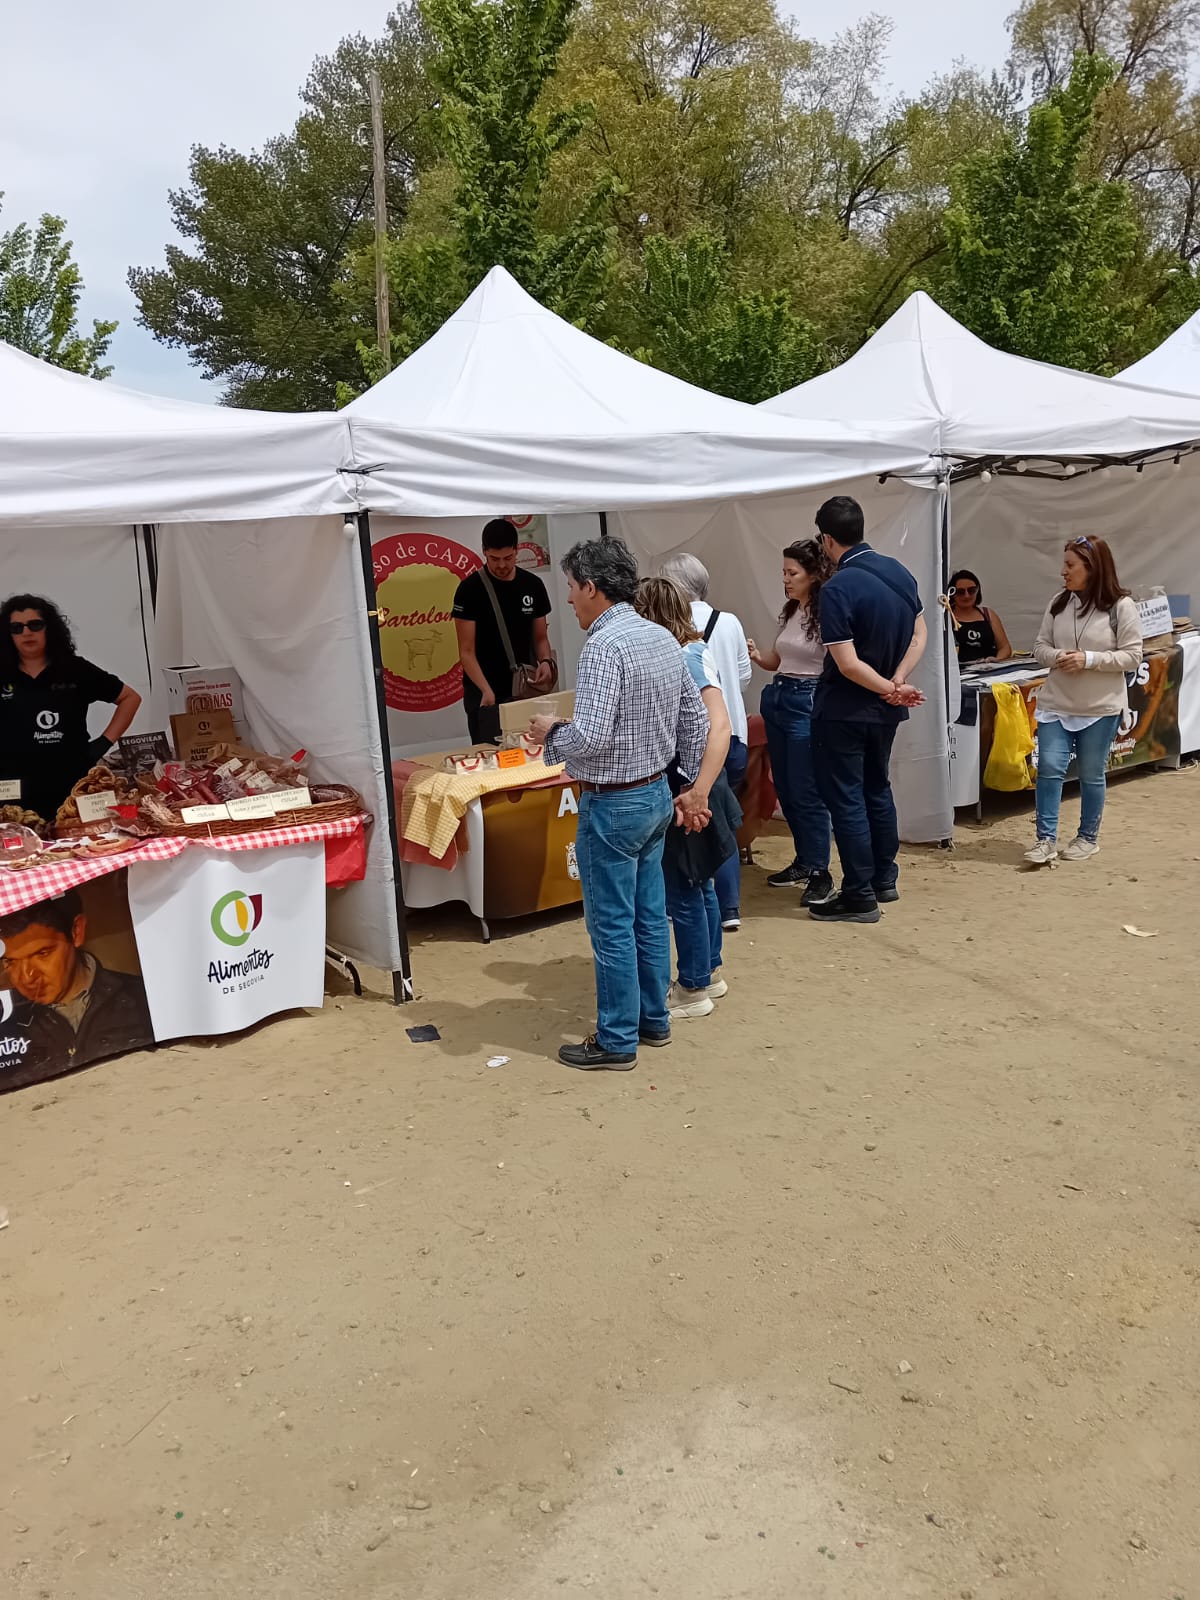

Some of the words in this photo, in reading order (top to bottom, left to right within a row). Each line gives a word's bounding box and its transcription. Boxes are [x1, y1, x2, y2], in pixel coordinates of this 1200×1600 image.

[372, 555, 391, 575] so
[395, 542, 417, 560] de
[207, 948, 274, 984] Alimentos
[222, 985, 236, 995] DE
[238, 974, 265, 991] SEGOVIA
